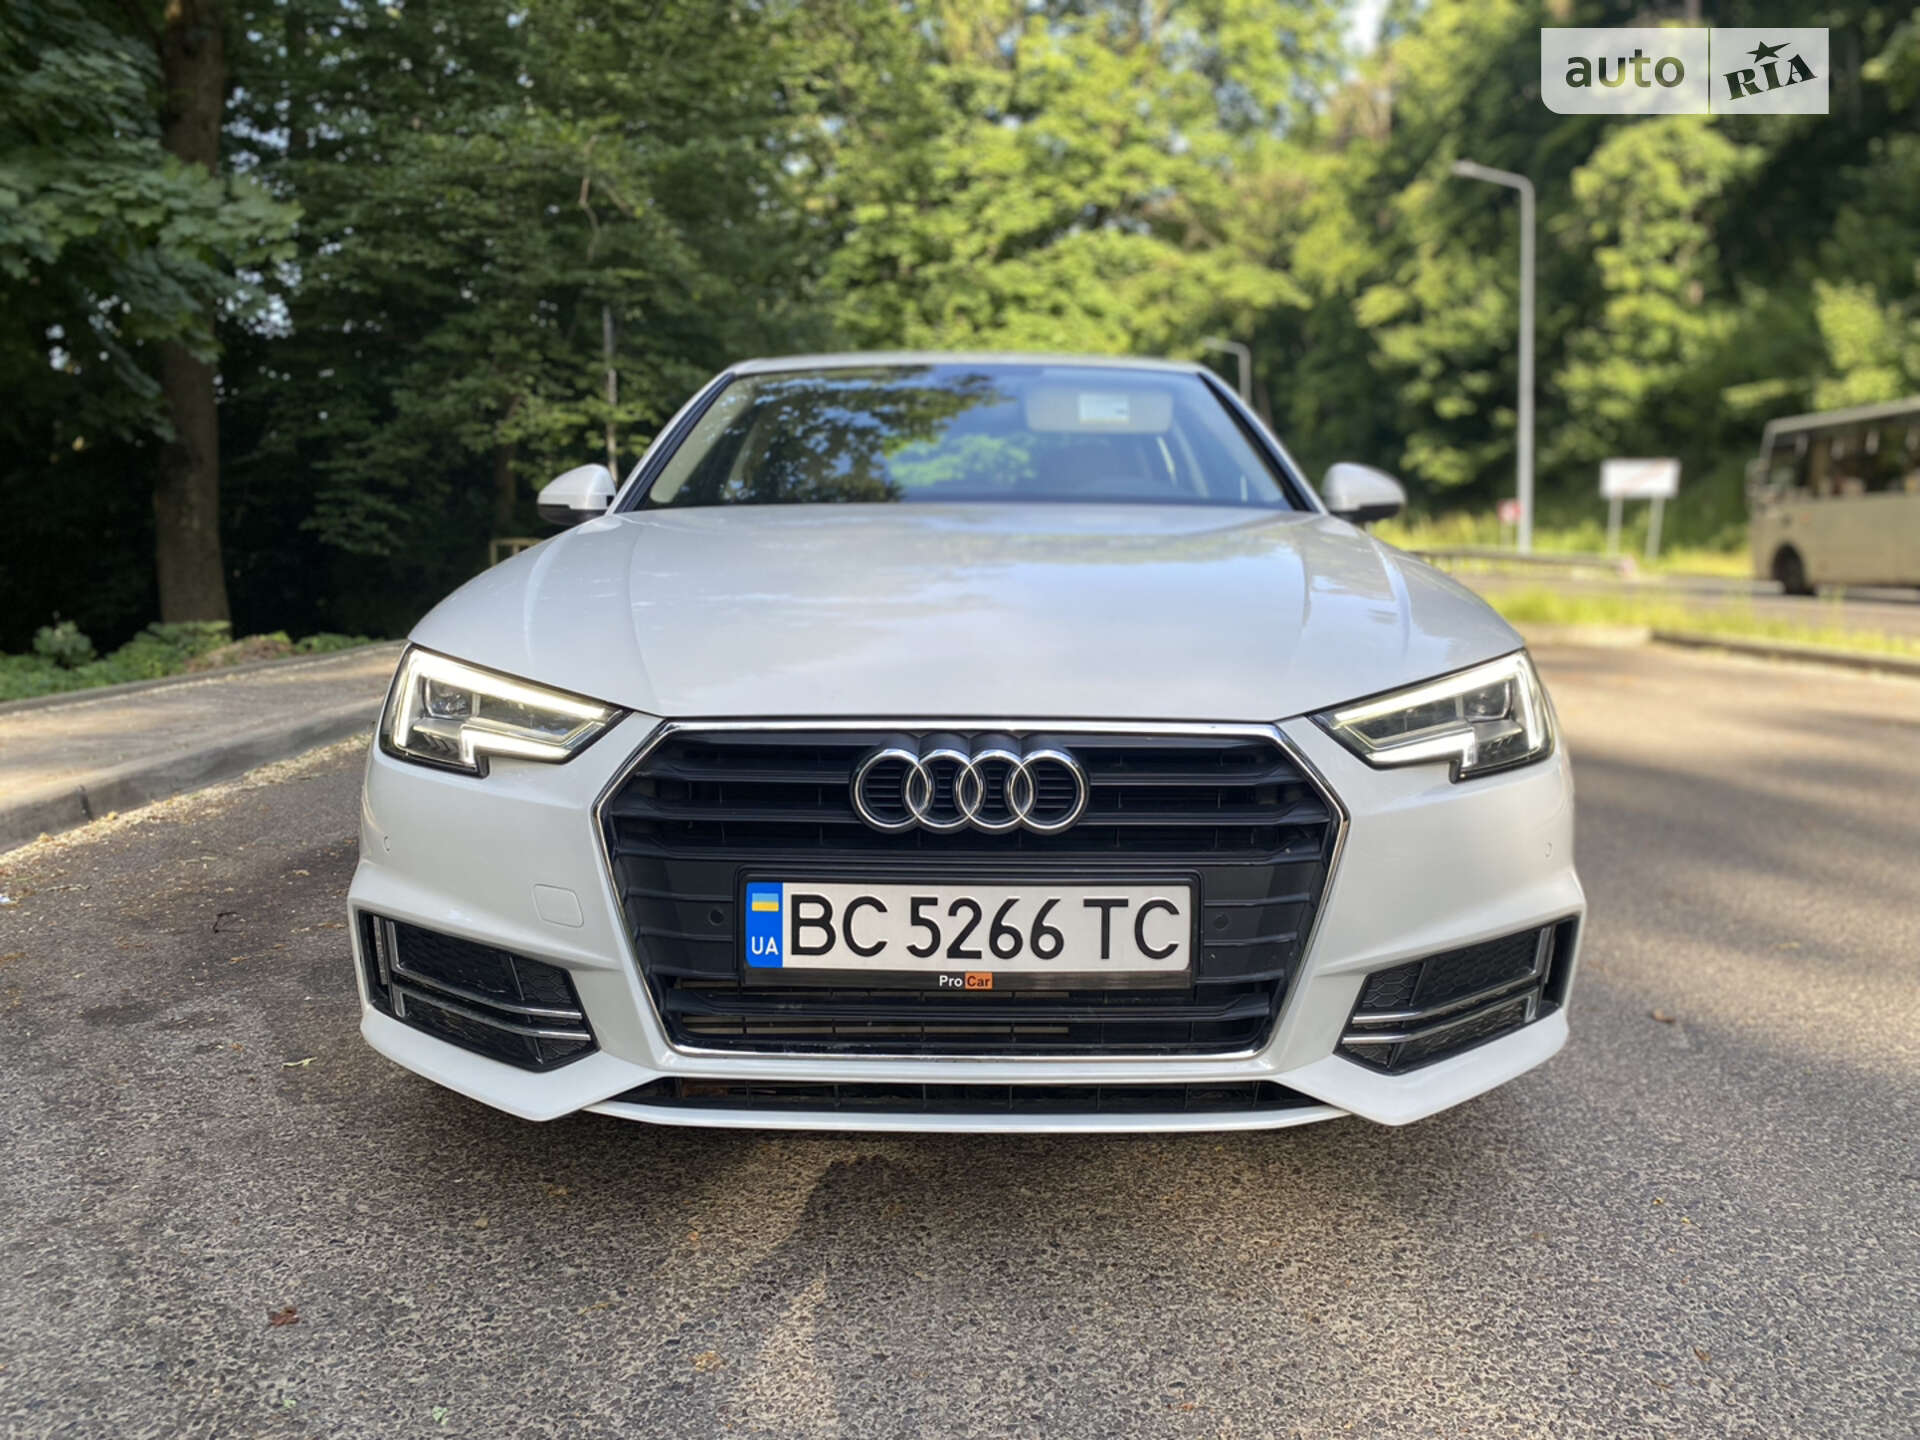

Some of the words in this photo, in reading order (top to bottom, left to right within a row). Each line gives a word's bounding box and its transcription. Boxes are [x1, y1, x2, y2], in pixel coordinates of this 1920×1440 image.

[790, 893, 889, 957] BC
[906, 896, 1065, 961] 5266
[1083, 897, 1181, 961] TC
[751, 935, 779, 956] UA
[938, 975, 963, 987] Pro
[966, 975, 990, 987] Car
